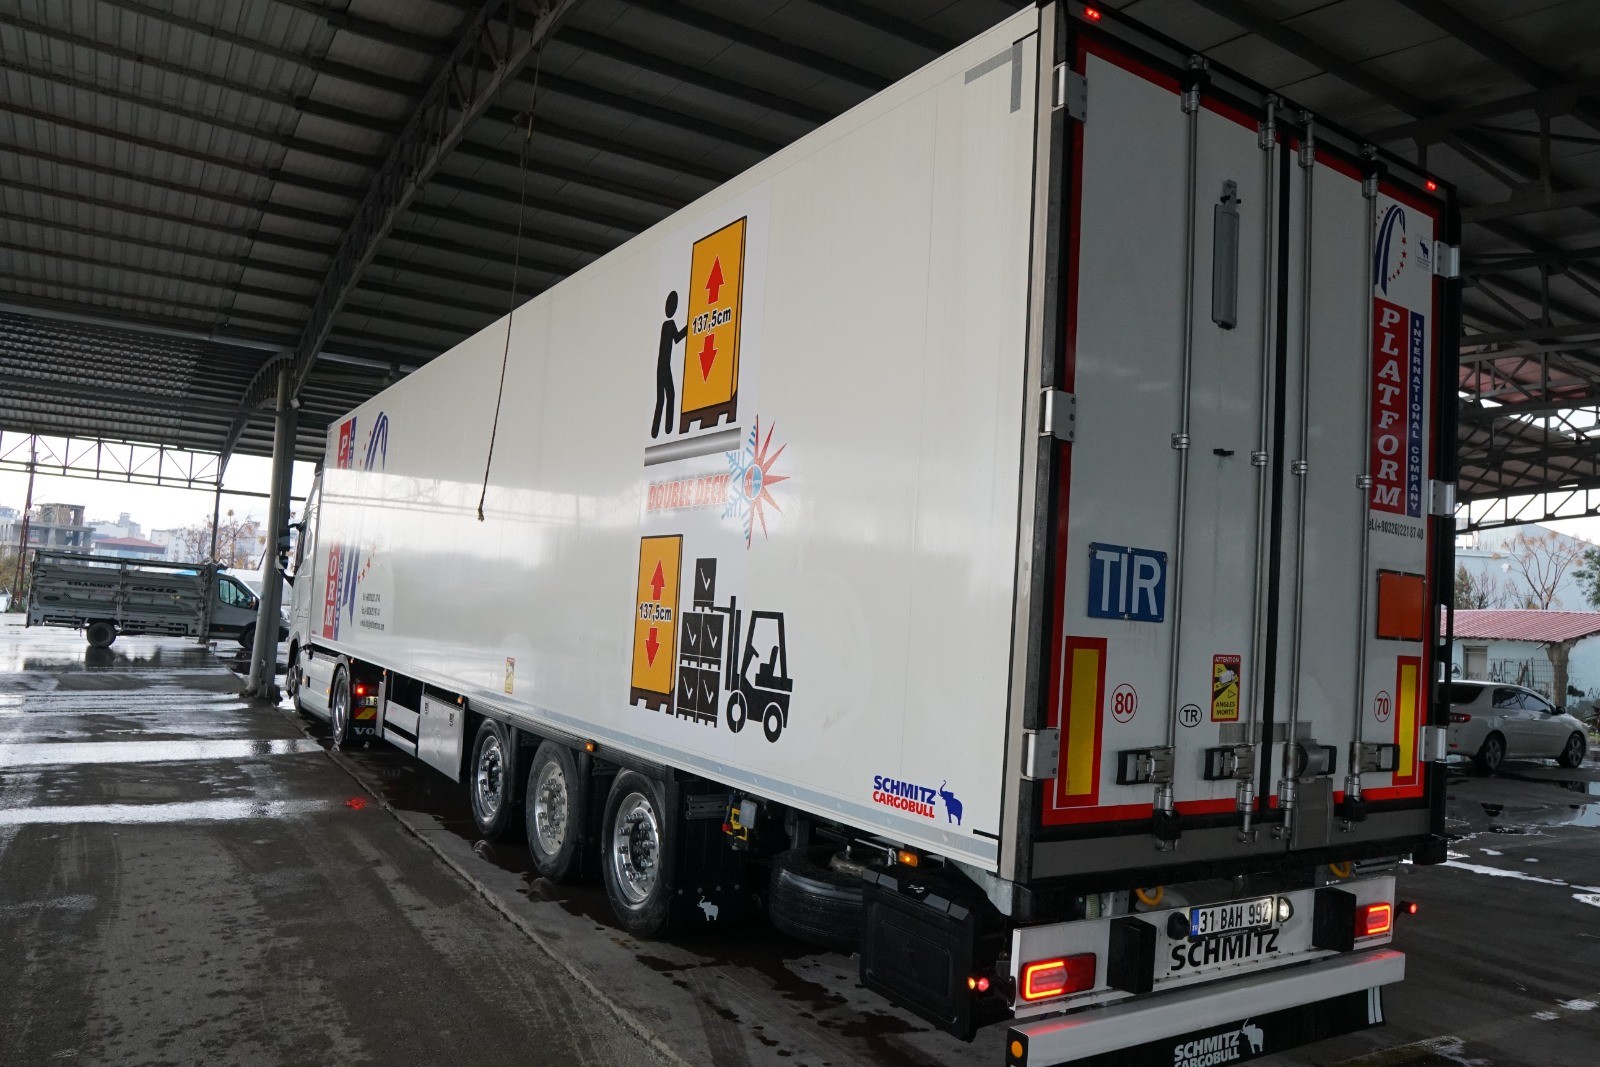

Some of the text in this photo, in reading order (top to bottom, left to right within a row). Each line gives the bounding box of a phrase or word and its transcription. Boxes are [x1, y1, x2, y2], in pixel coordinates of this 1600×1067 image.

[692, 308, 732, 334] 137,5cm
[1373, 307, 1401, 507] PLATFORM
[1410, 319, 1422, 510] INTERNATIONAL COMPANY
[647, 474, 731, 511] DOUBLE DECK
[1096, 550, 1161, 615] TIR
[639, 602, 672, 624] 137,5cm
[1115, 692, 1134, 714] 80
[1183, 709, 1198, 722] TR
[1377, 698, 1389, 715] 70
[873, 775, 937, 805] SCHMITZ
[873, 791, 935, 818] CARGOBULL
[1200, 901, 1269, 933] 31 BAH 992
[1170, 928, 1280, 971] SCHMITZ
[1174, 1029, 1241, 1062] SCHMITZ
[1174, 1046, 1240, 1067] CARGOBULL
